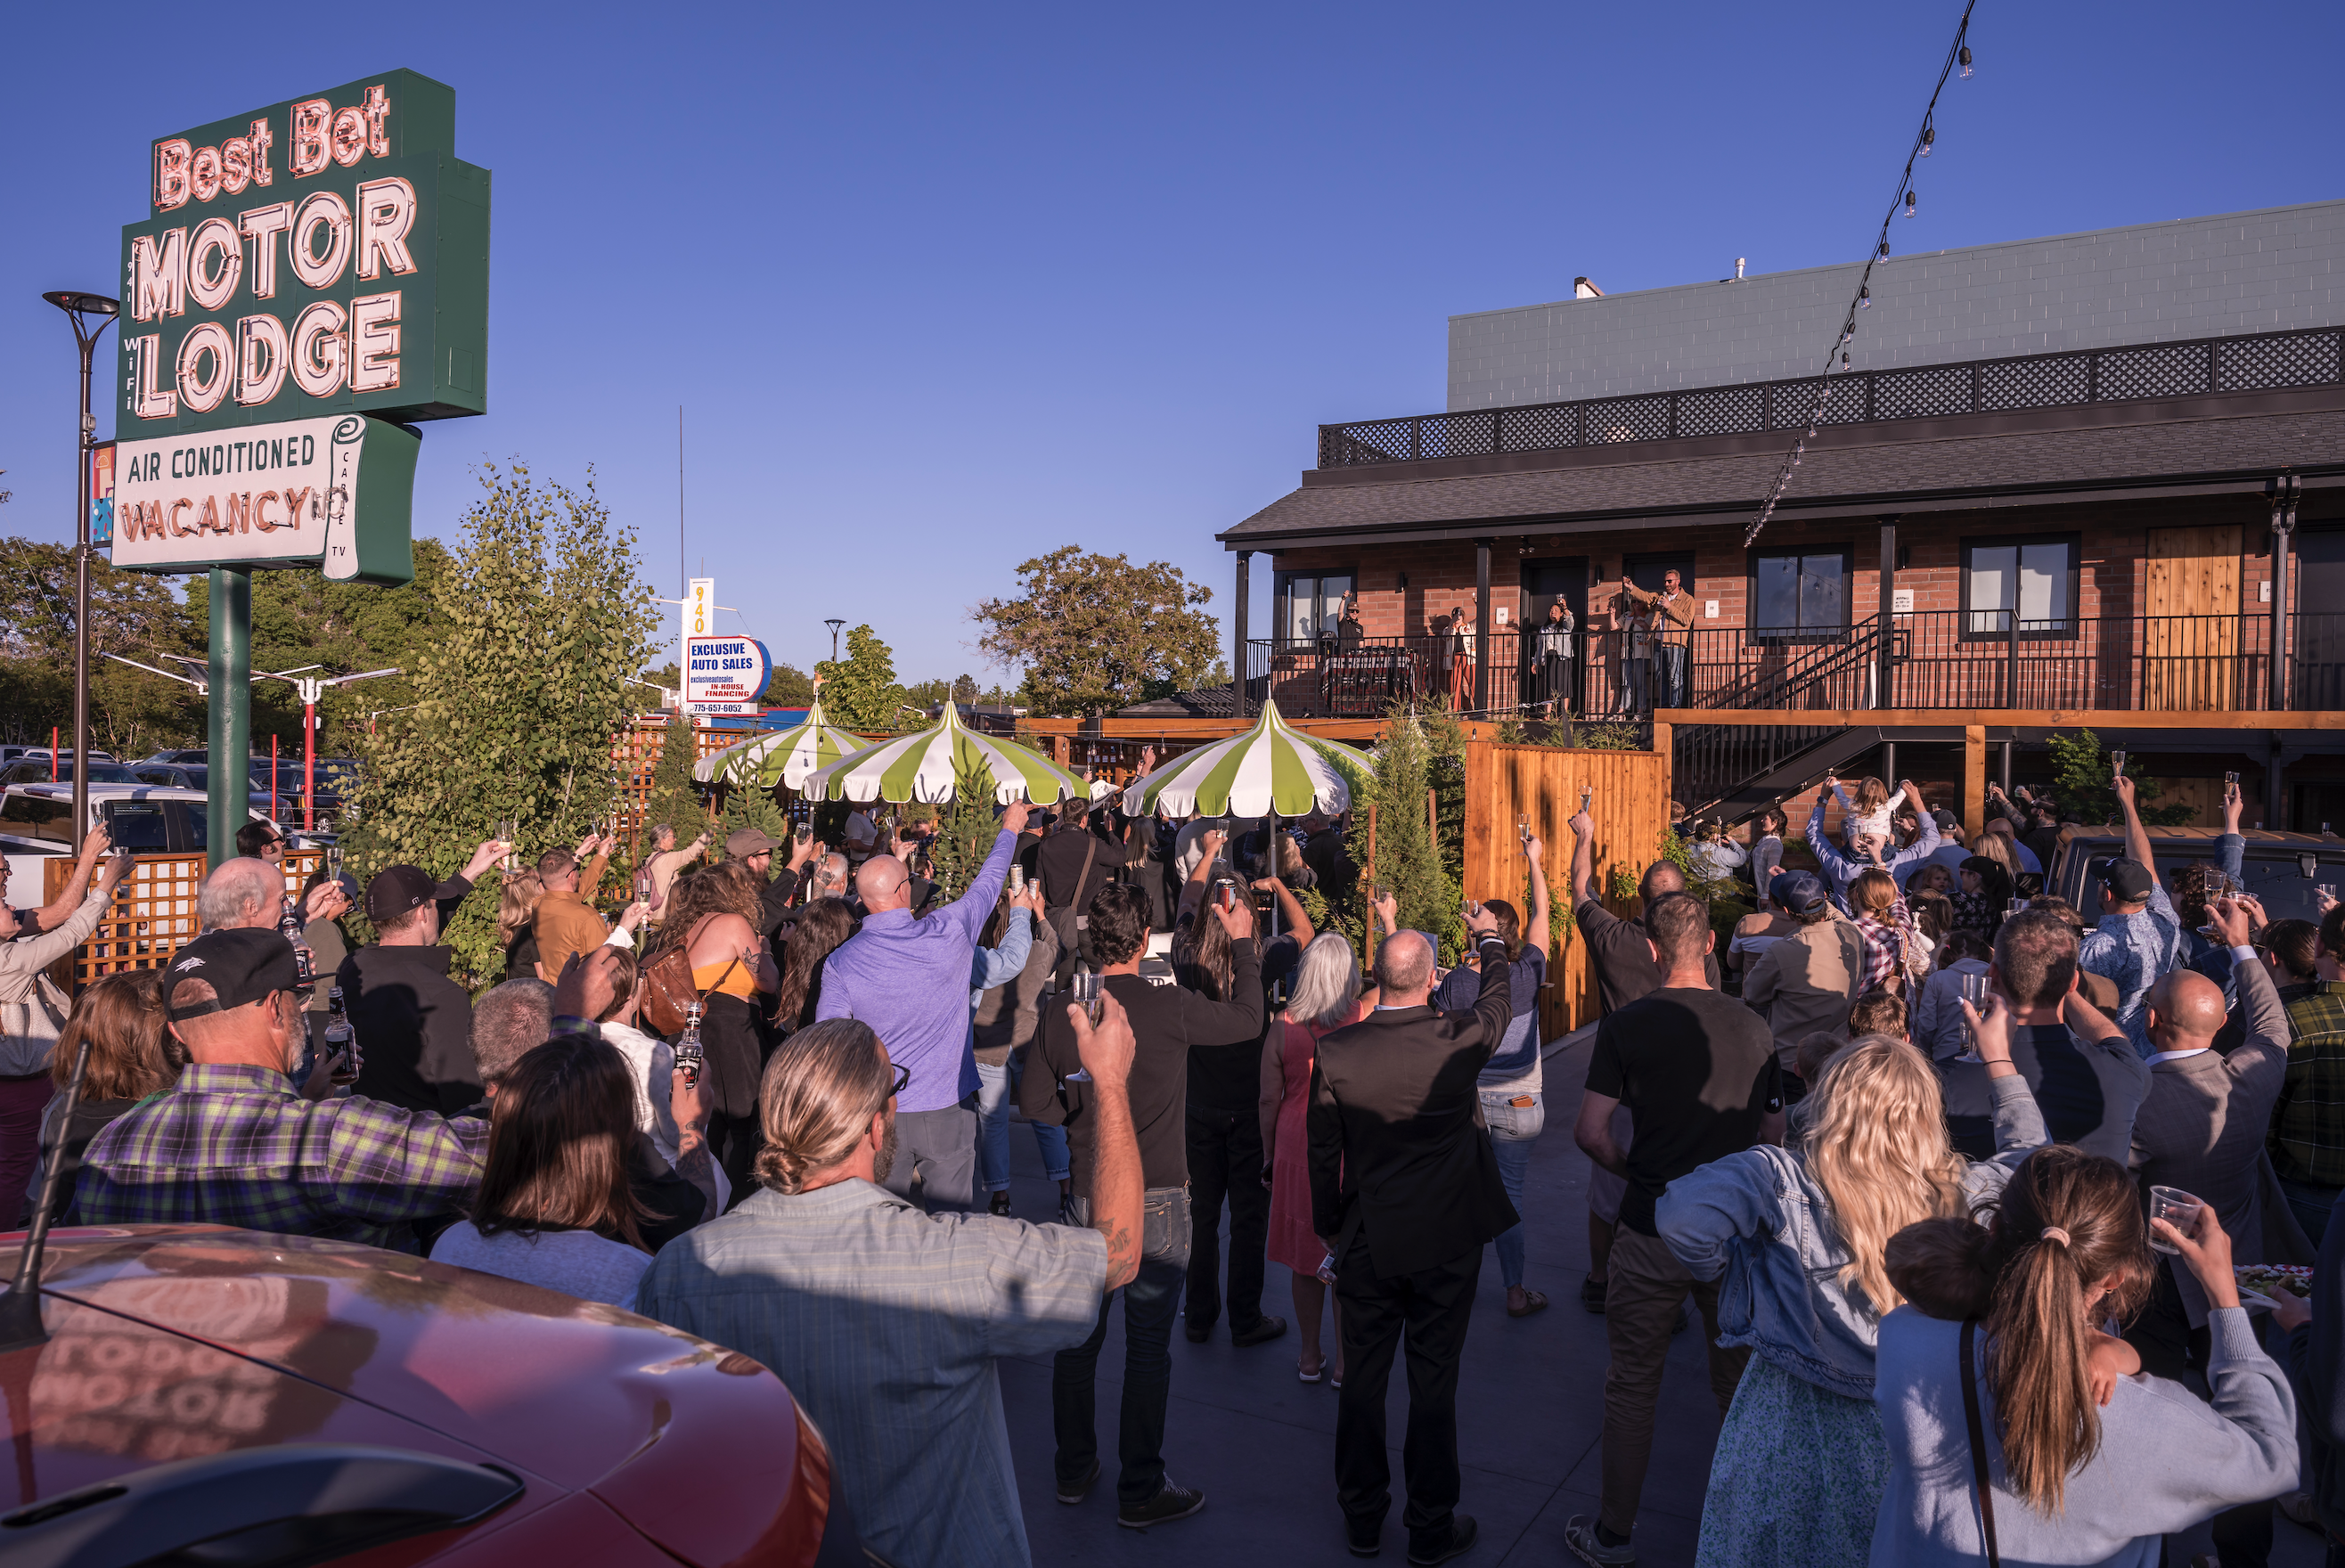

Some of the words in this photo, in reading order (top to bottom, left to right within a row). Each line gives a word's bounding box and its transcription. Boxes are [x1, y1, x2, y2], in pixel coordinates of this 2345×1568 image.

[153, 118, 273, 213] Best
[289, 85, 390, 179] Bet
[132, 176, 418, 325] MOTOR
[135, 290, 401, 421] LODGE
[128, 452, 161, 484] AIR
[172, 435, 315, 478] CONDITIONED
[339, 452, 349, 526] CABE
[118, 486, 311, 543] VACANCY
[311, 486, 348, 520] NO
[332, 546, 346, 557] TV
[695, 586, 704, 633] 940
[691, 643, 746, 656] EXCLUSIVE
[691, 659, 718, 670] AUTO
[723, 657, 753, 670] SALES
[690, 675, 733, 683] exclusiveautosales
[694, 704, 742, 713] 775-657-6052
